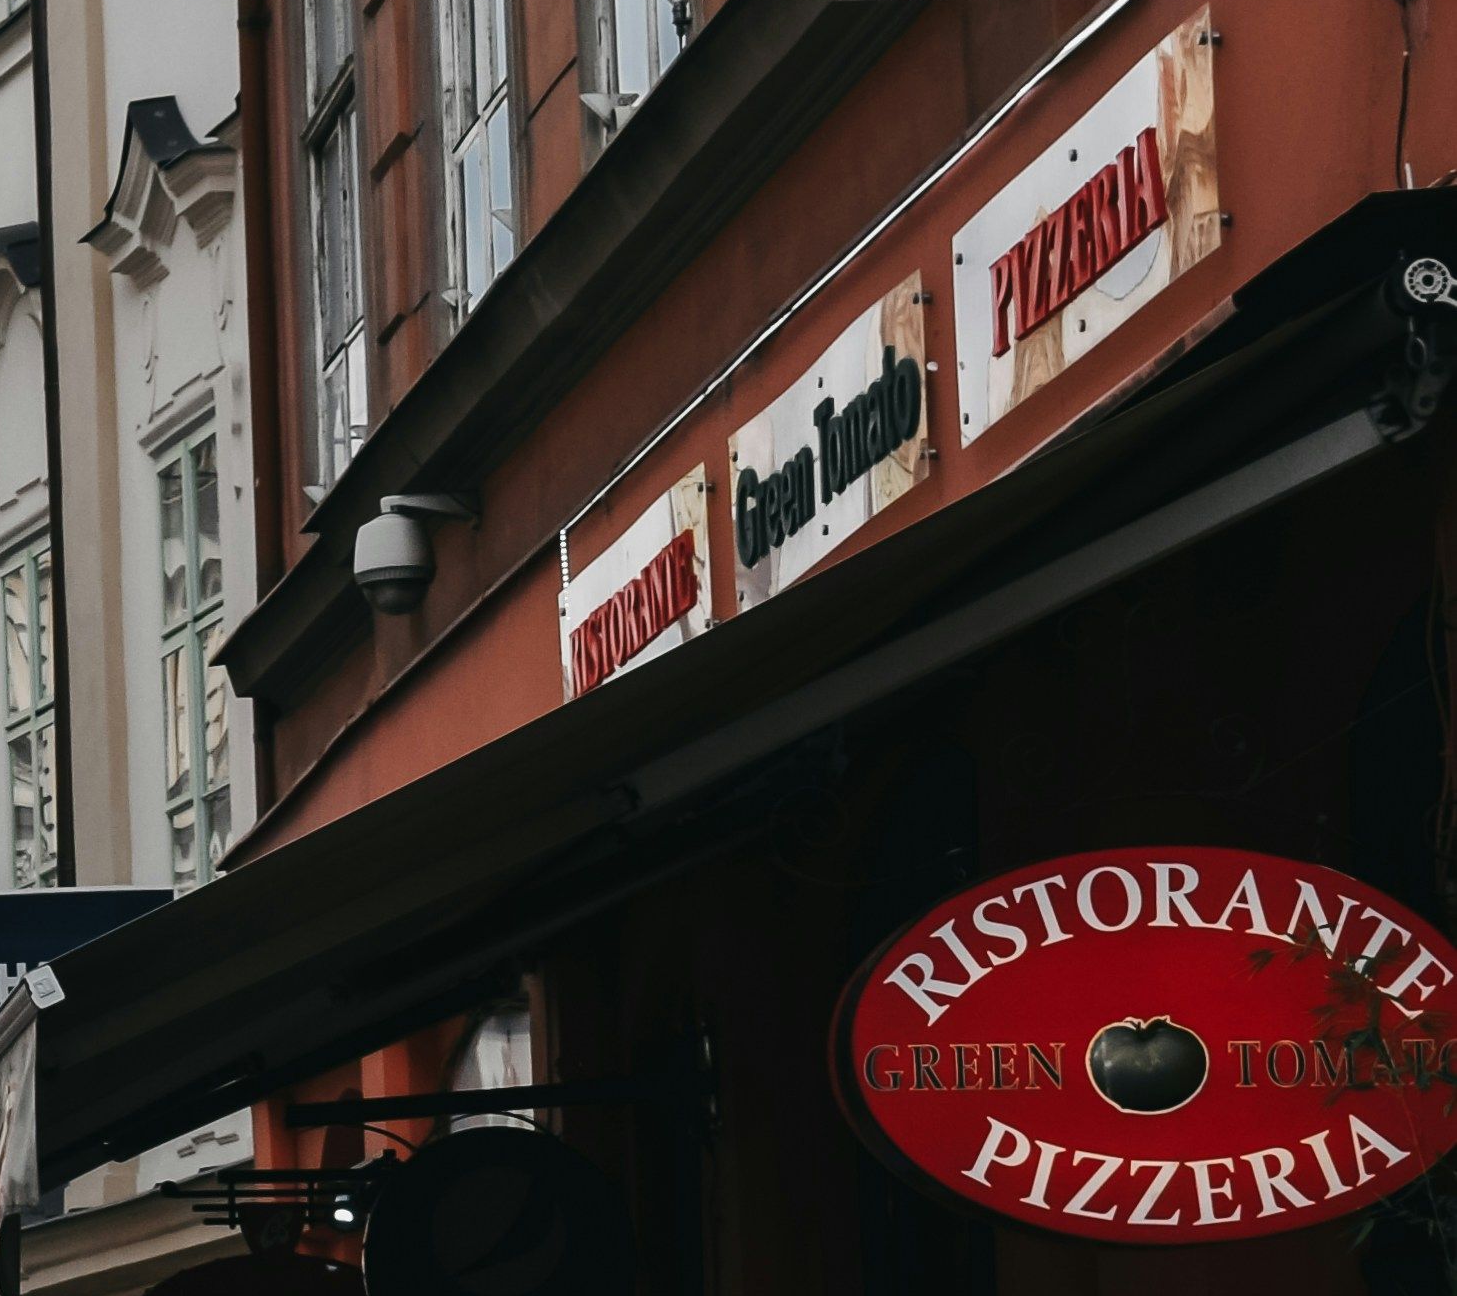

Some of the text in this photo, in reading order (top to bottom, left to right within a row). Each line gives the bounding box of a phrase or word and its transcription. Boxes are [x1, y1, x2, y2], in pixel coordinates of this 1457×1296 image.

[989, 126, 1169, 358] PIZZERIA
[734, 345, 923, 569] Green Tomato
[569, 528, 699, 700] RISTORANTE
[882, 862, 1454, 1028] RISTORANTE
[863, 1042, 1066, 1093] GREEN
[961, 1113, 1411, 1227] PIZZERIA
